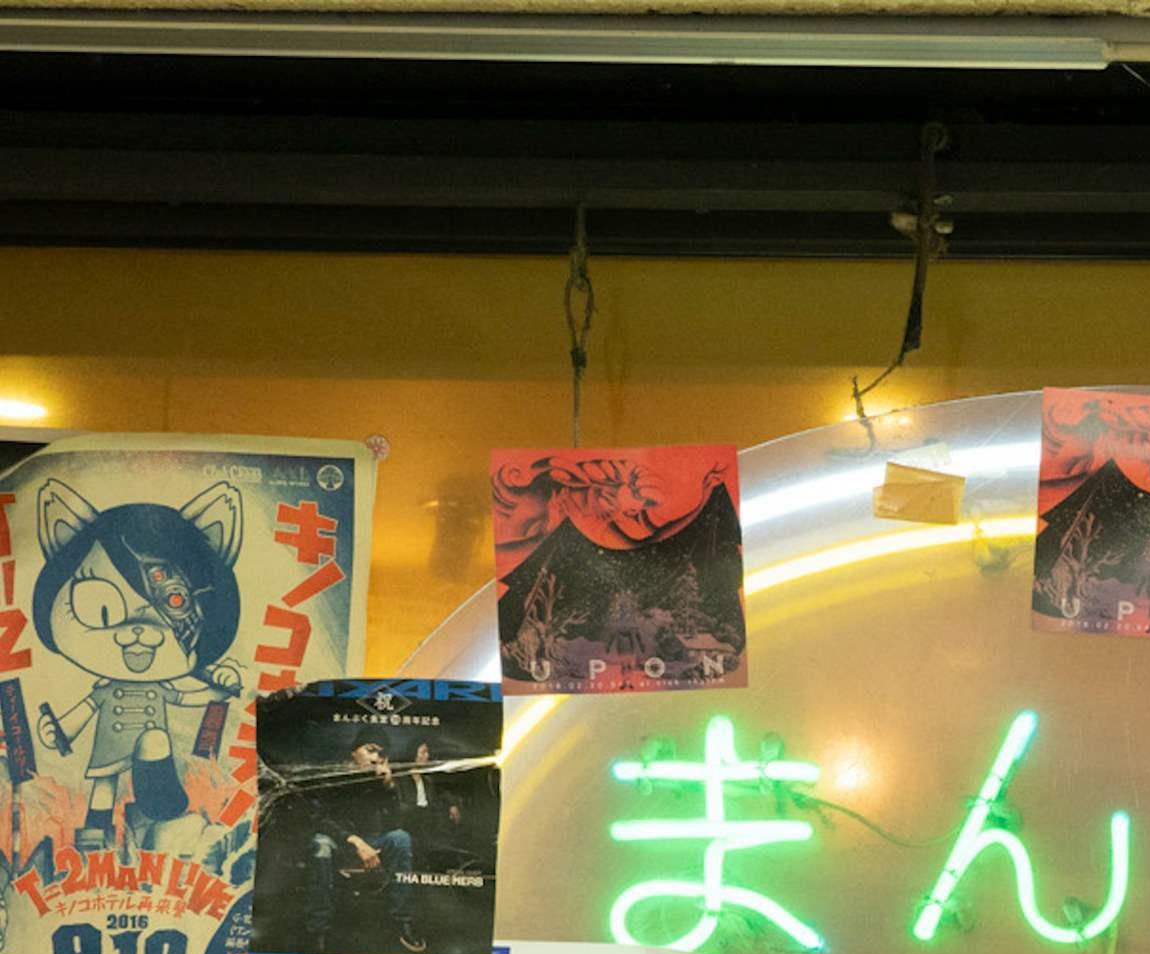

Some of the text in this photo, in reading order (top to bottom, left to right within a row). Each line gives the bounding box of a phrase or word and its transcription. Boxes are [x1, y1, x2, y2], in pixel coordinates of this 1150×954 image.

[395, 872, 419, 884] THA
[421, 873, 450, 885] BLUE
[107, 914, 149, 930] 2016
